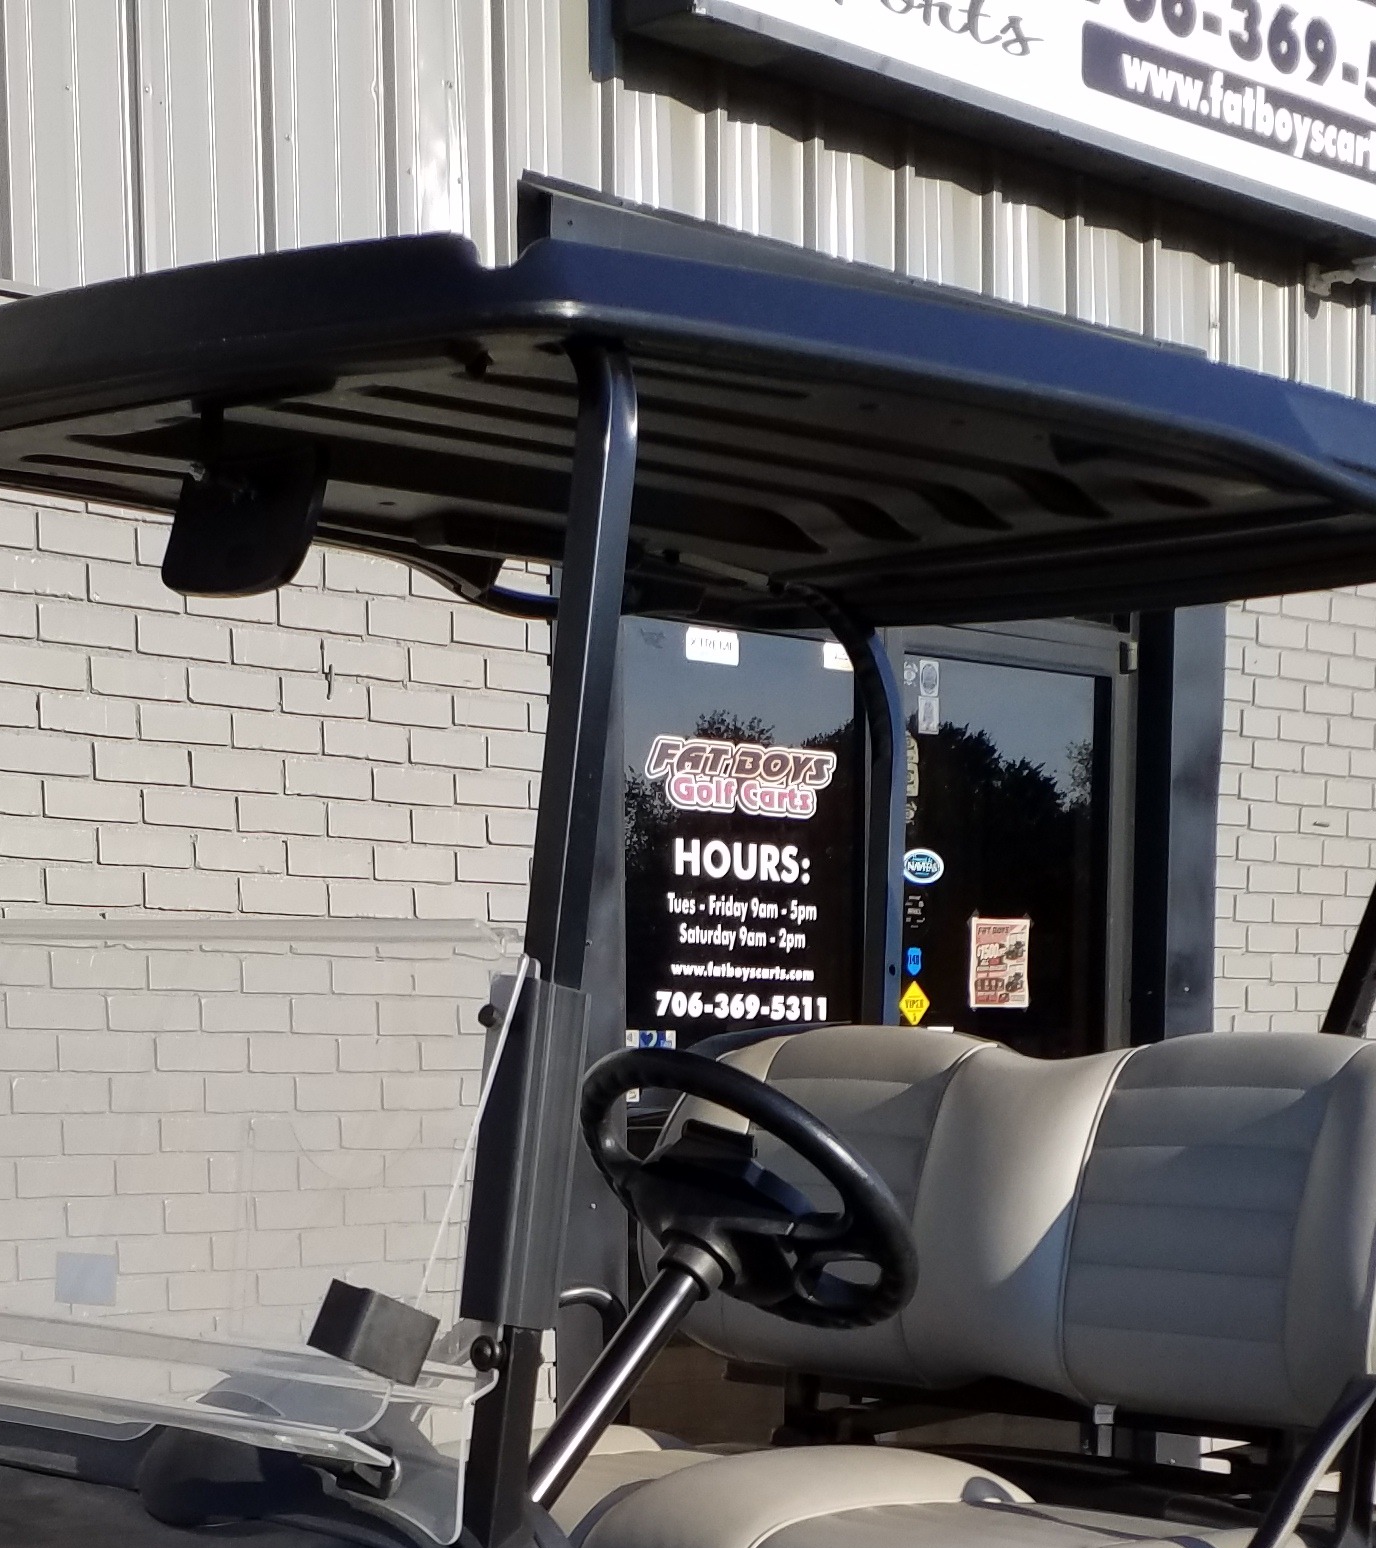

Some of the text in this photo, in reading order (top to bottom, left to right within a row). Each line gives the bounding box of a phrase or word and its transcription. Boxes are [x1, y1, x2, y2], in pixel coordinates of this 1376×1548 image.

[649, 739, 833, 786] FAT BOYS
[673, 776, 812, 812] Golf Carts
[674, 837, 811, 885] HOURS:
[666, 891, 696, 915] Tues
[708, 894, 748, 923] Friday
[750, 897, 779, 920] 9am
[789, 899, 818, 926] 5pm
[679, 922, 736, 951] Saturday
[739, 926, 767, 947] 9am
[778, 928, 806, 953] 2pm
[670, 960, 815, 982] www.fatboyscarts.com
[655, 990, 827, 1022] 706-369-5311
